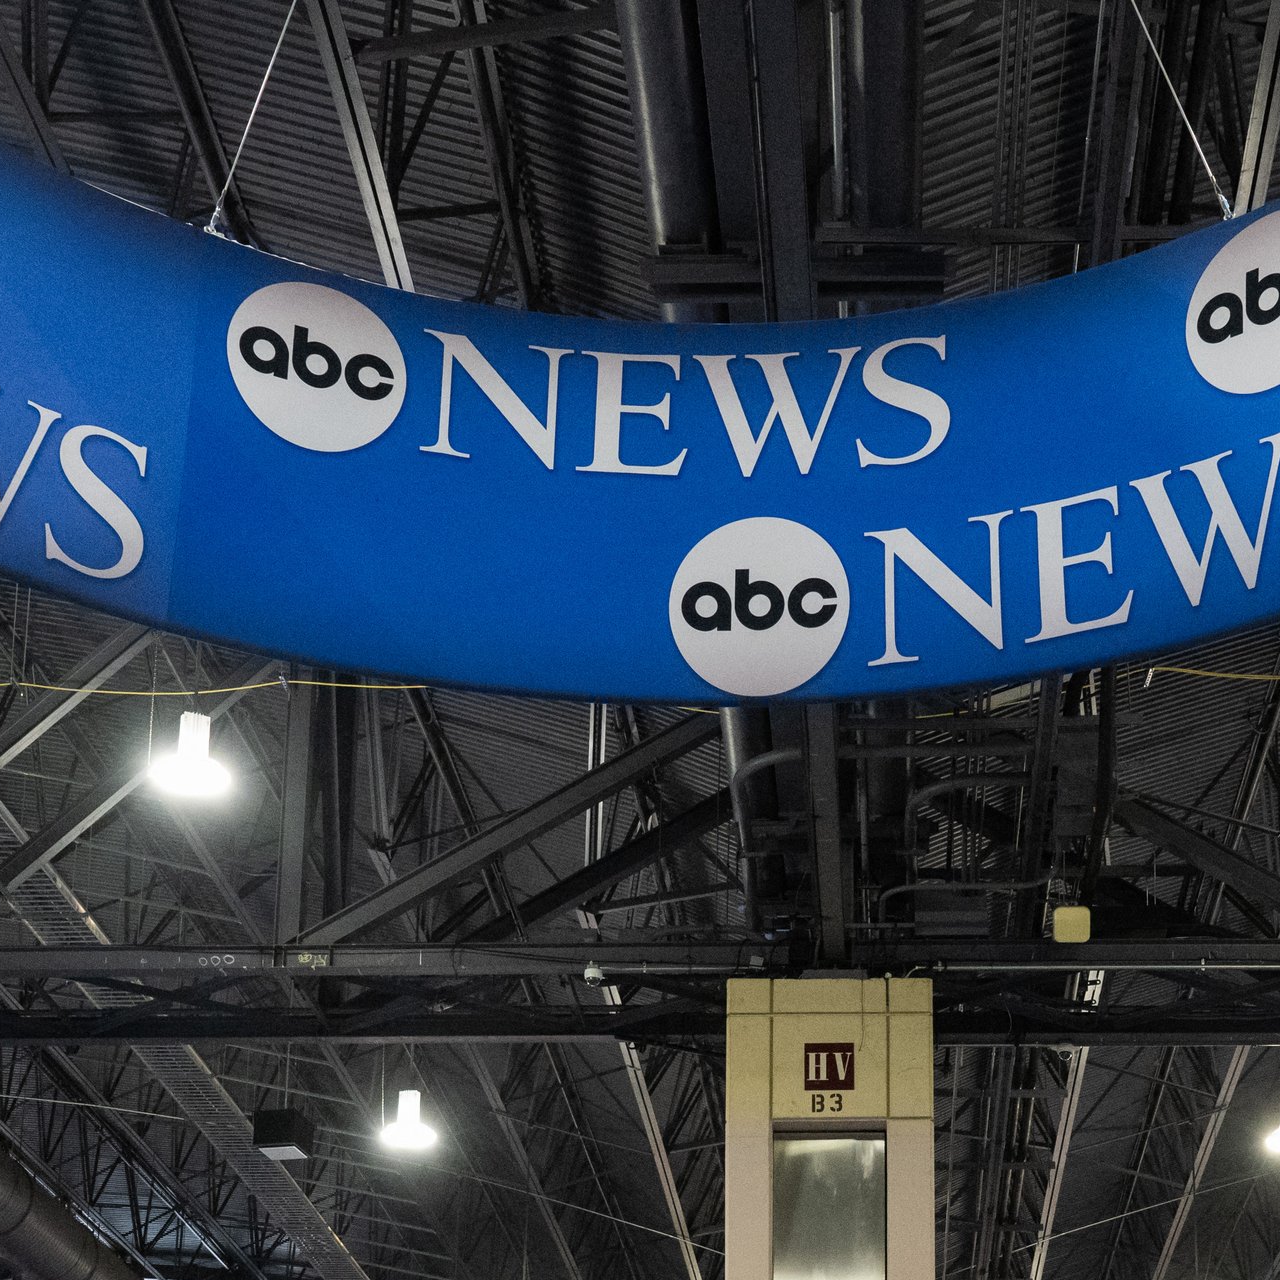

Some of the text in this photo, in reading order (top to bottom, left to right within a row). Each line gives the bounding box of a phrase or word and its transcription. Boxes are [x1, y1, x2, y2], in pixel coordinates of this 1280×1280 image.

[239, 326, 952, 478] abc NEWS
[681, 569, 837, 632] abc
[806, 1052, 853, 1081] HV
